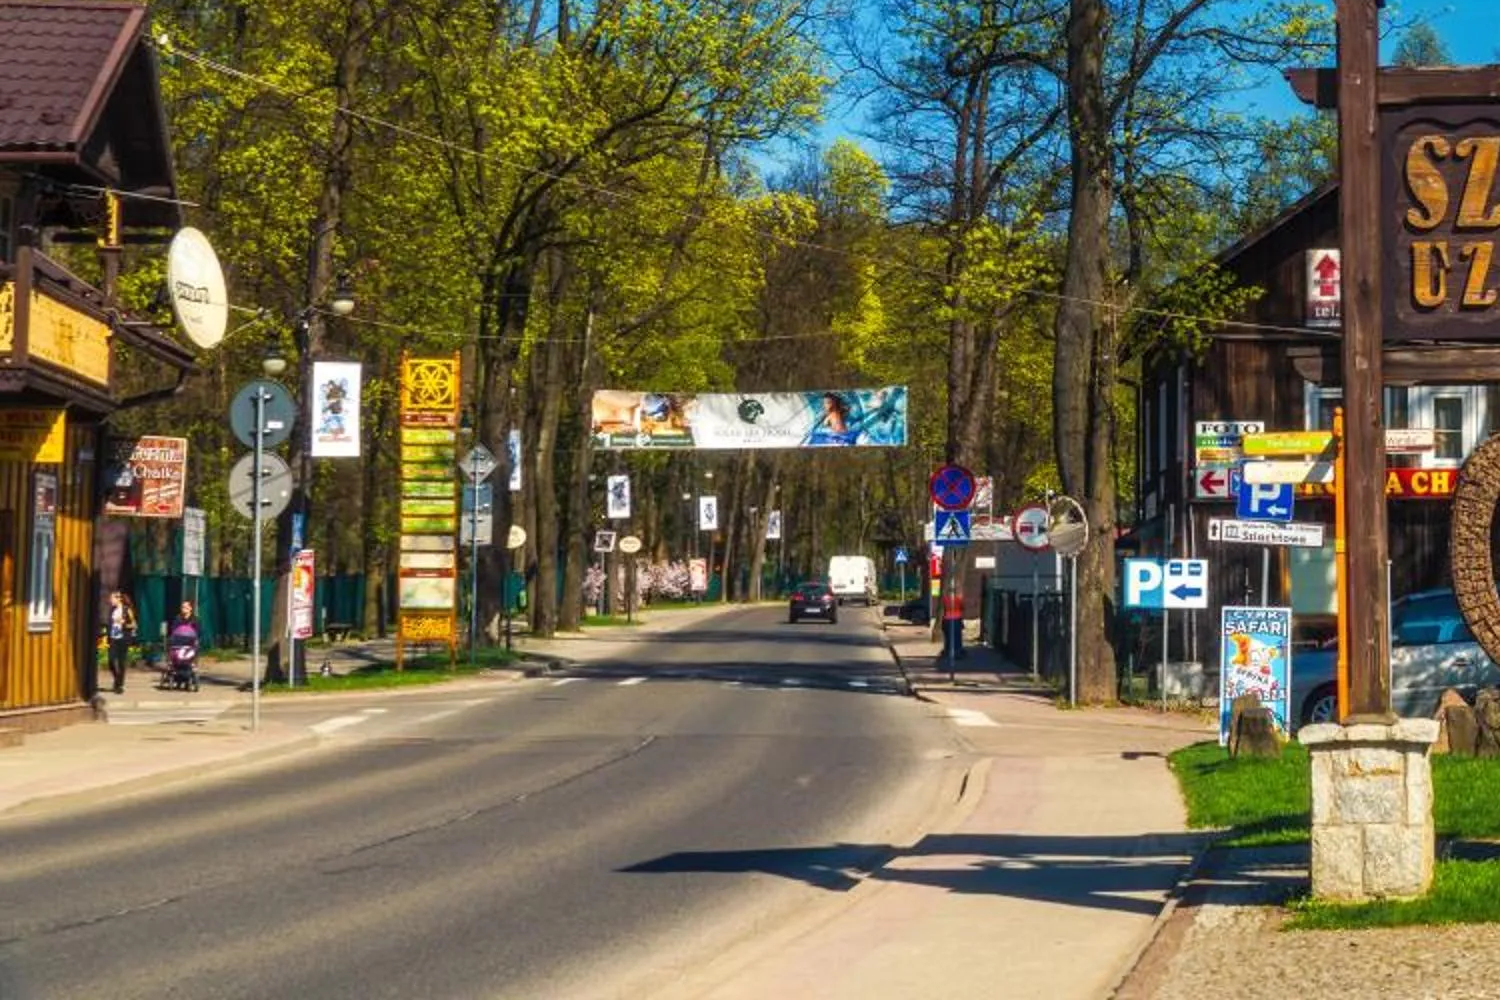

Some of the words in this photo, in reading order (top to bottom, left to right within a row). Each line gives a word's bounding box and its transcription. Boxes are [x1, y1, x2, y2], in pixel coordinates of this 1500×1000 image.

[1201, 422, 1260, 434] FOTO
[1251, 483, 1281, 513] P
[1128, 560, 1162, 605] P
[1225, 621, 1287, 638] SAFARI
